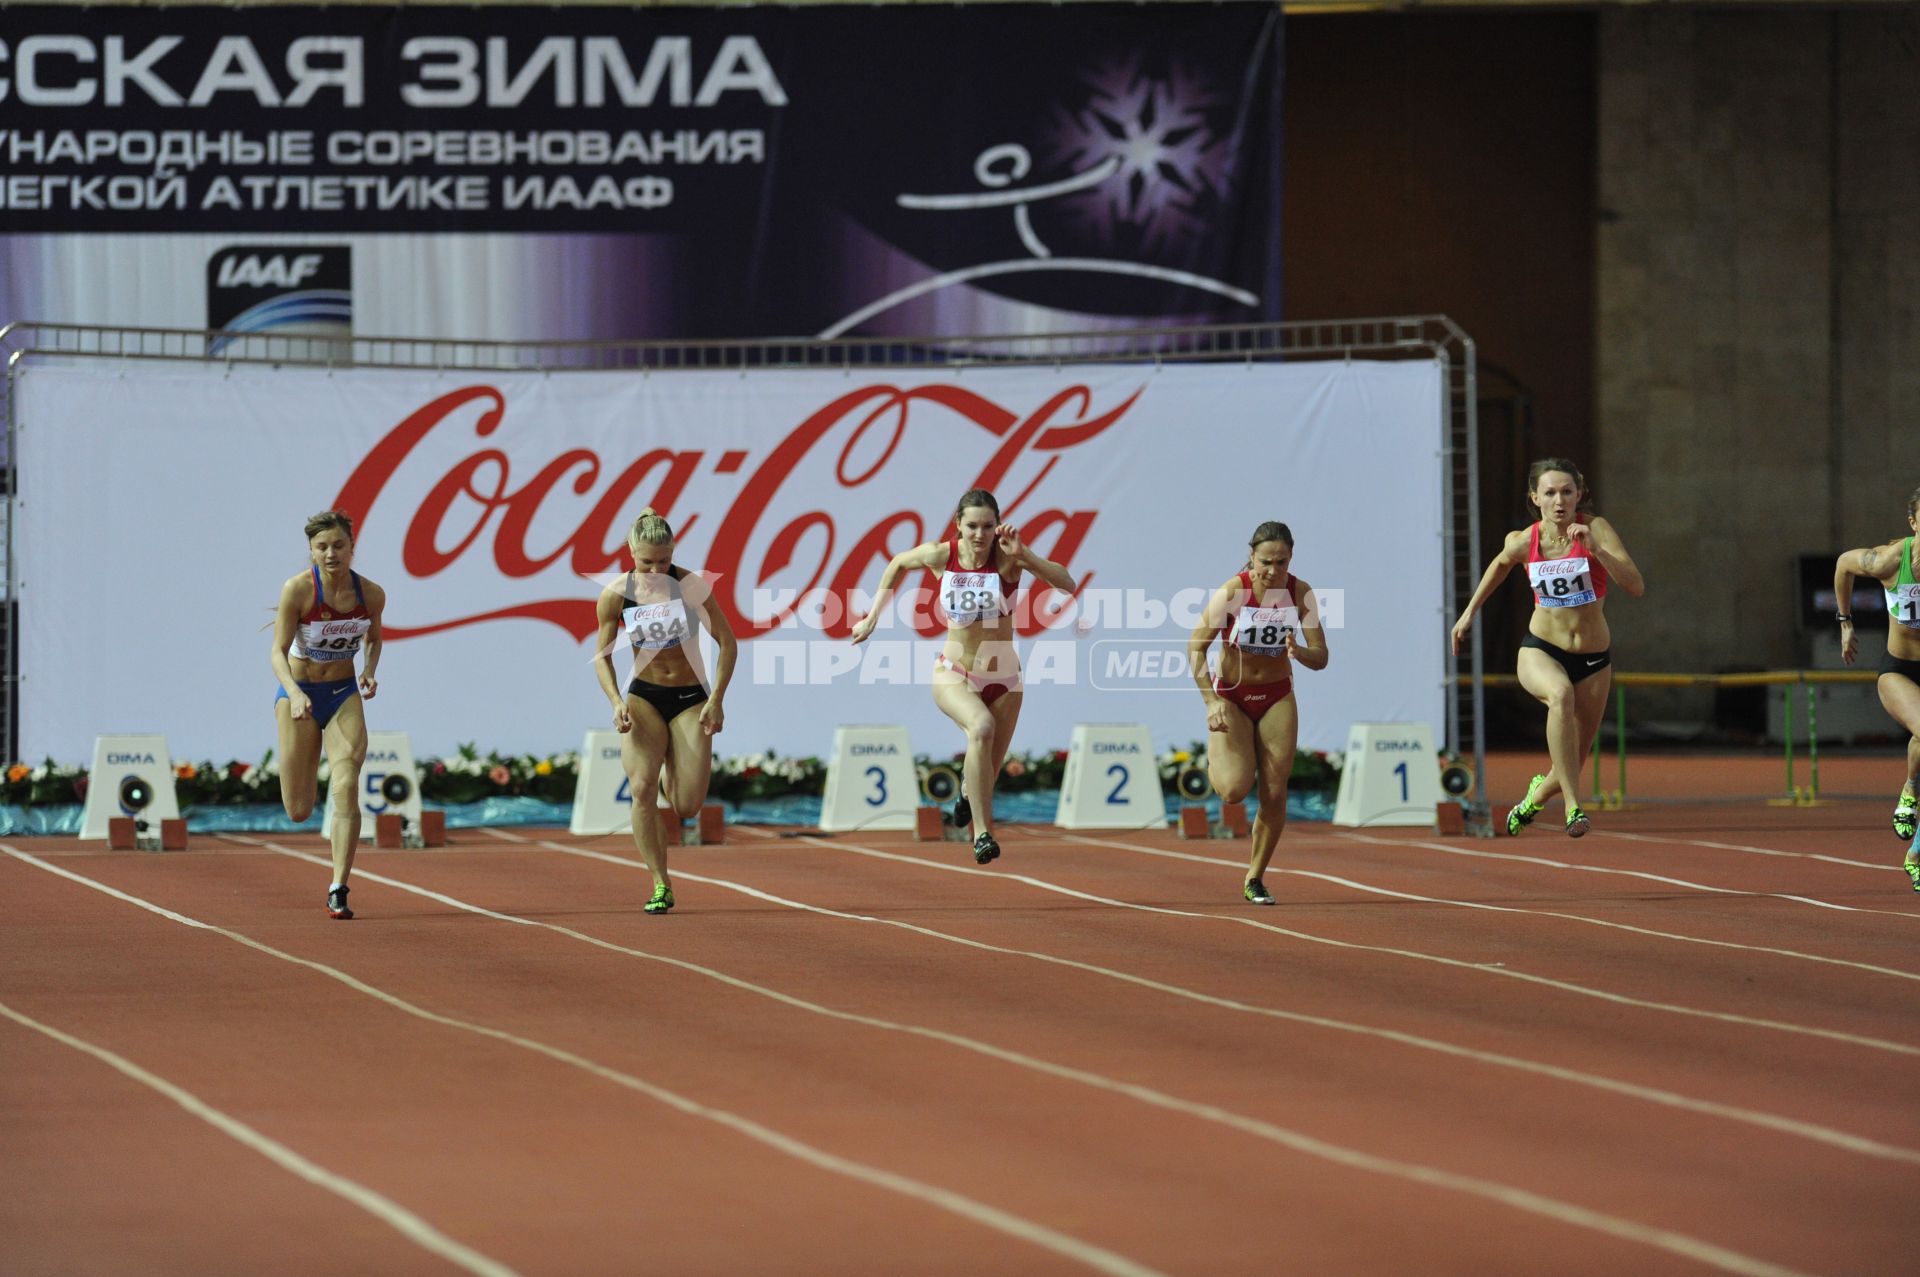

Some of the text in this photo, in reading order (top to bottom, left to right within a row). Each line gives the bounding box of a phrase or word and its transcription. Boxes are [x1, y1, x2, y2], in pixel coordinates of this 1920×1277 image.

[0, 35, 789, 108] СКАЯ ЗИМА
[0, 130, 765, 171] НАРОДНЫЕ СОРЕВНОВАНИЯ
[0, 170, 674, 210] ЕГКОЙ АТЛЕТИКЕ ИААФ
[216, 254, 324, 288] IAAF
[332, 384, 1146, 643] Coca-Cola
[945, 590, 996, 612] 183
[1535, 575, 1586, 596] 181
[630, 617, 685, 643] 184
[107, 752, 155, 765] DIMA
[850, 744, 899, 756] DIMA
[1093, 742, 1140, 754] DIMA
[1374, 740, 1423, 751] DIMA
[865, 766, 888, 806] 3
[1106, 764, 1129, 804] 2
[1394, 762, 1408, 802] 1
